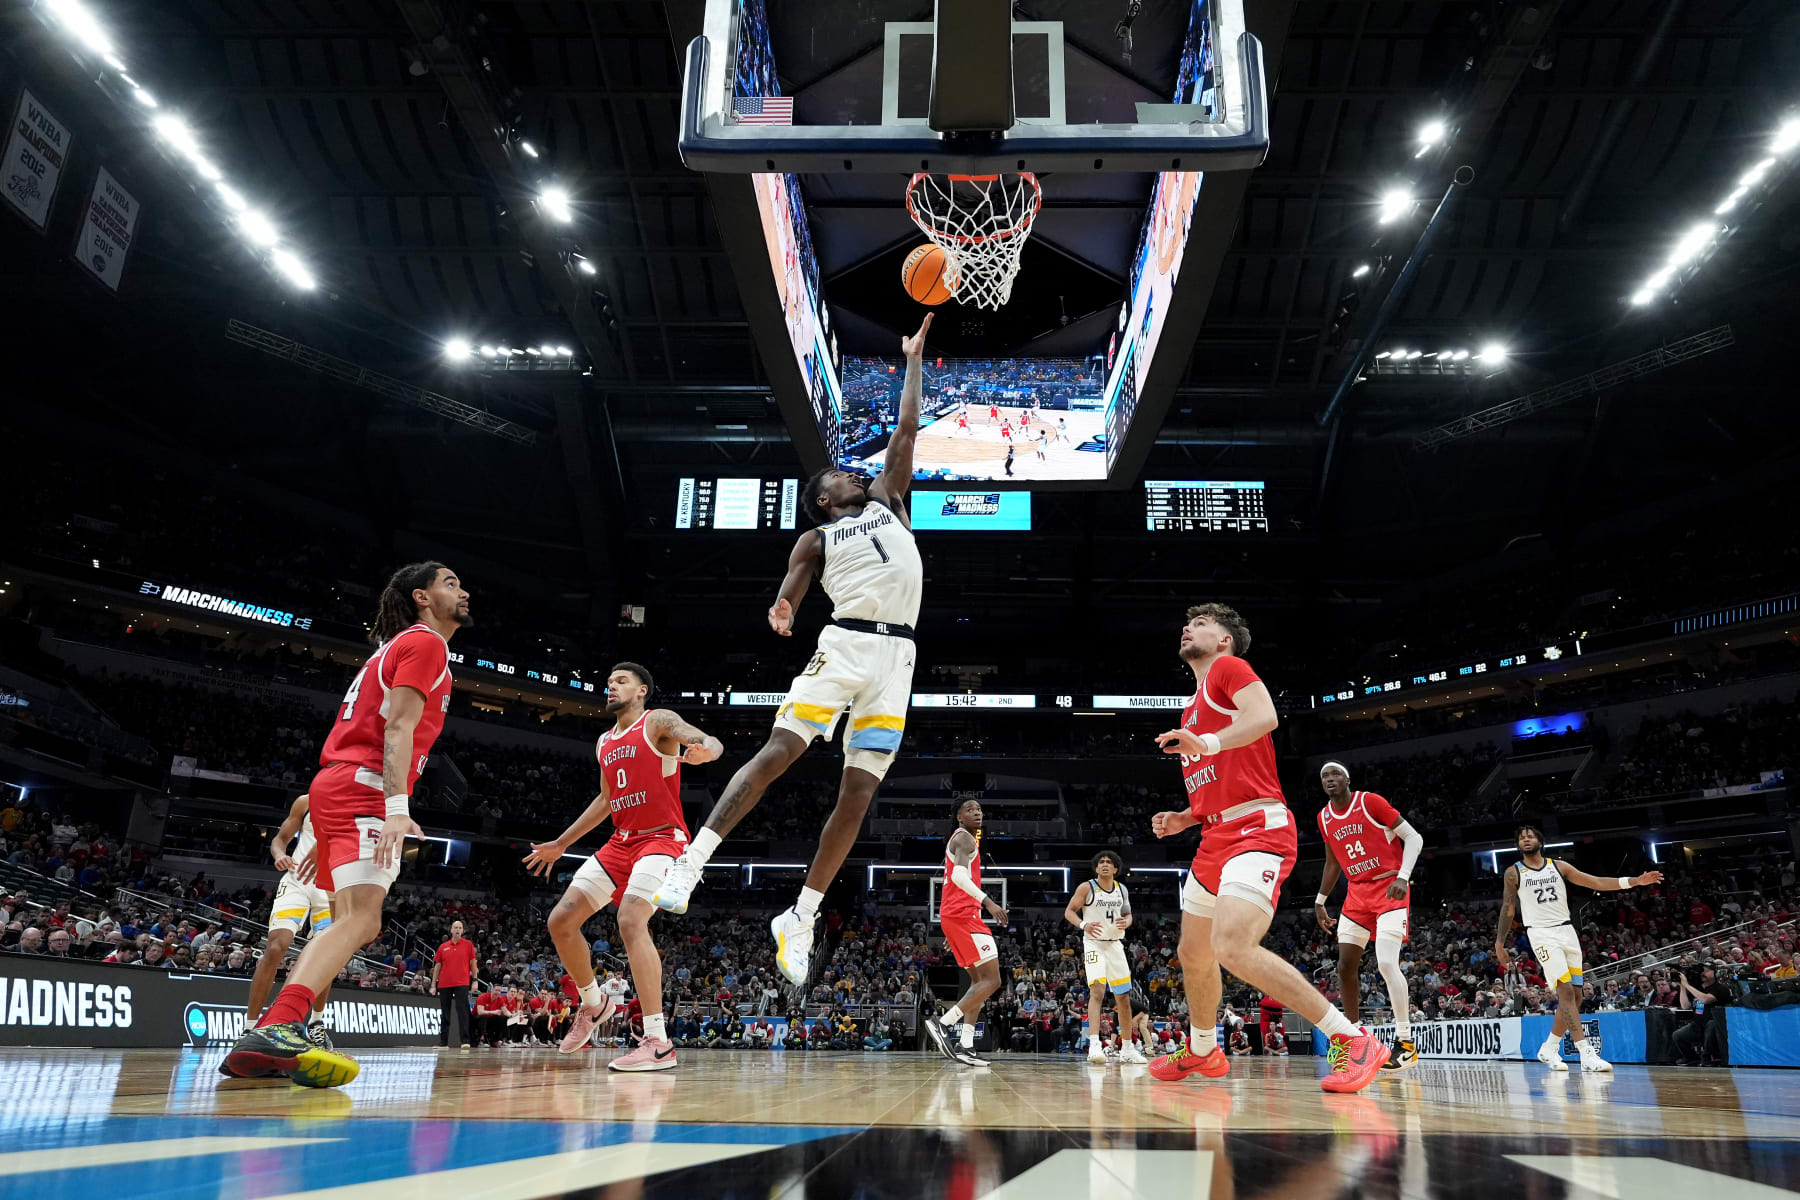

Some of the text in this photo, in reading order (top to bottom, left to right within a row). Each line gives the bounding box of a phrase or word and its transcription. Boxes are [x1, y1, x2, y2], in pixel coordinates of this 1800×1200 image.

[28, 103, 61, 147] WNBA
[20, 148, 46, 180] 2012
[105, 180, 129, 213] WNBA
[94, 234, 114, 258] 2015
[955, 495, 985, 503] MARCH
[957, 503, 998, 512] MADNESS
[832, 512, 893, 546] Marquette
[870, 535, 889, 563] 1
[1459, 666, 1473, 675] REB
[1475, 663, 1487, 673] 22
[1500, 658, 1513, 668] AST
[1515, 655, 1526, 665] 12
[341, 665, 369, 721] 4
[945, 695, 977, 706] 15:42
[1055, 696, 1073, 707] 48
[1129, 698, 1183, 707] MARQUETTE
[603, 745, 637, 767] WESTERN
[617, 768, 627, 788] 0
[1333, 824, 1363, 842] WESTERN
[1345, 840, 1367, 859] 24
[1347, 857, 1381, 876] KENTUCKY
[1534, 886, 1558, 904] 23
[1106, 910, 1114, 924] 4
[207, 1010, 263, 1040] MAR
[1411, 1024, 1443, 1054] ECOND
[1447, 1022, 1500, 1055] ROUNDS
